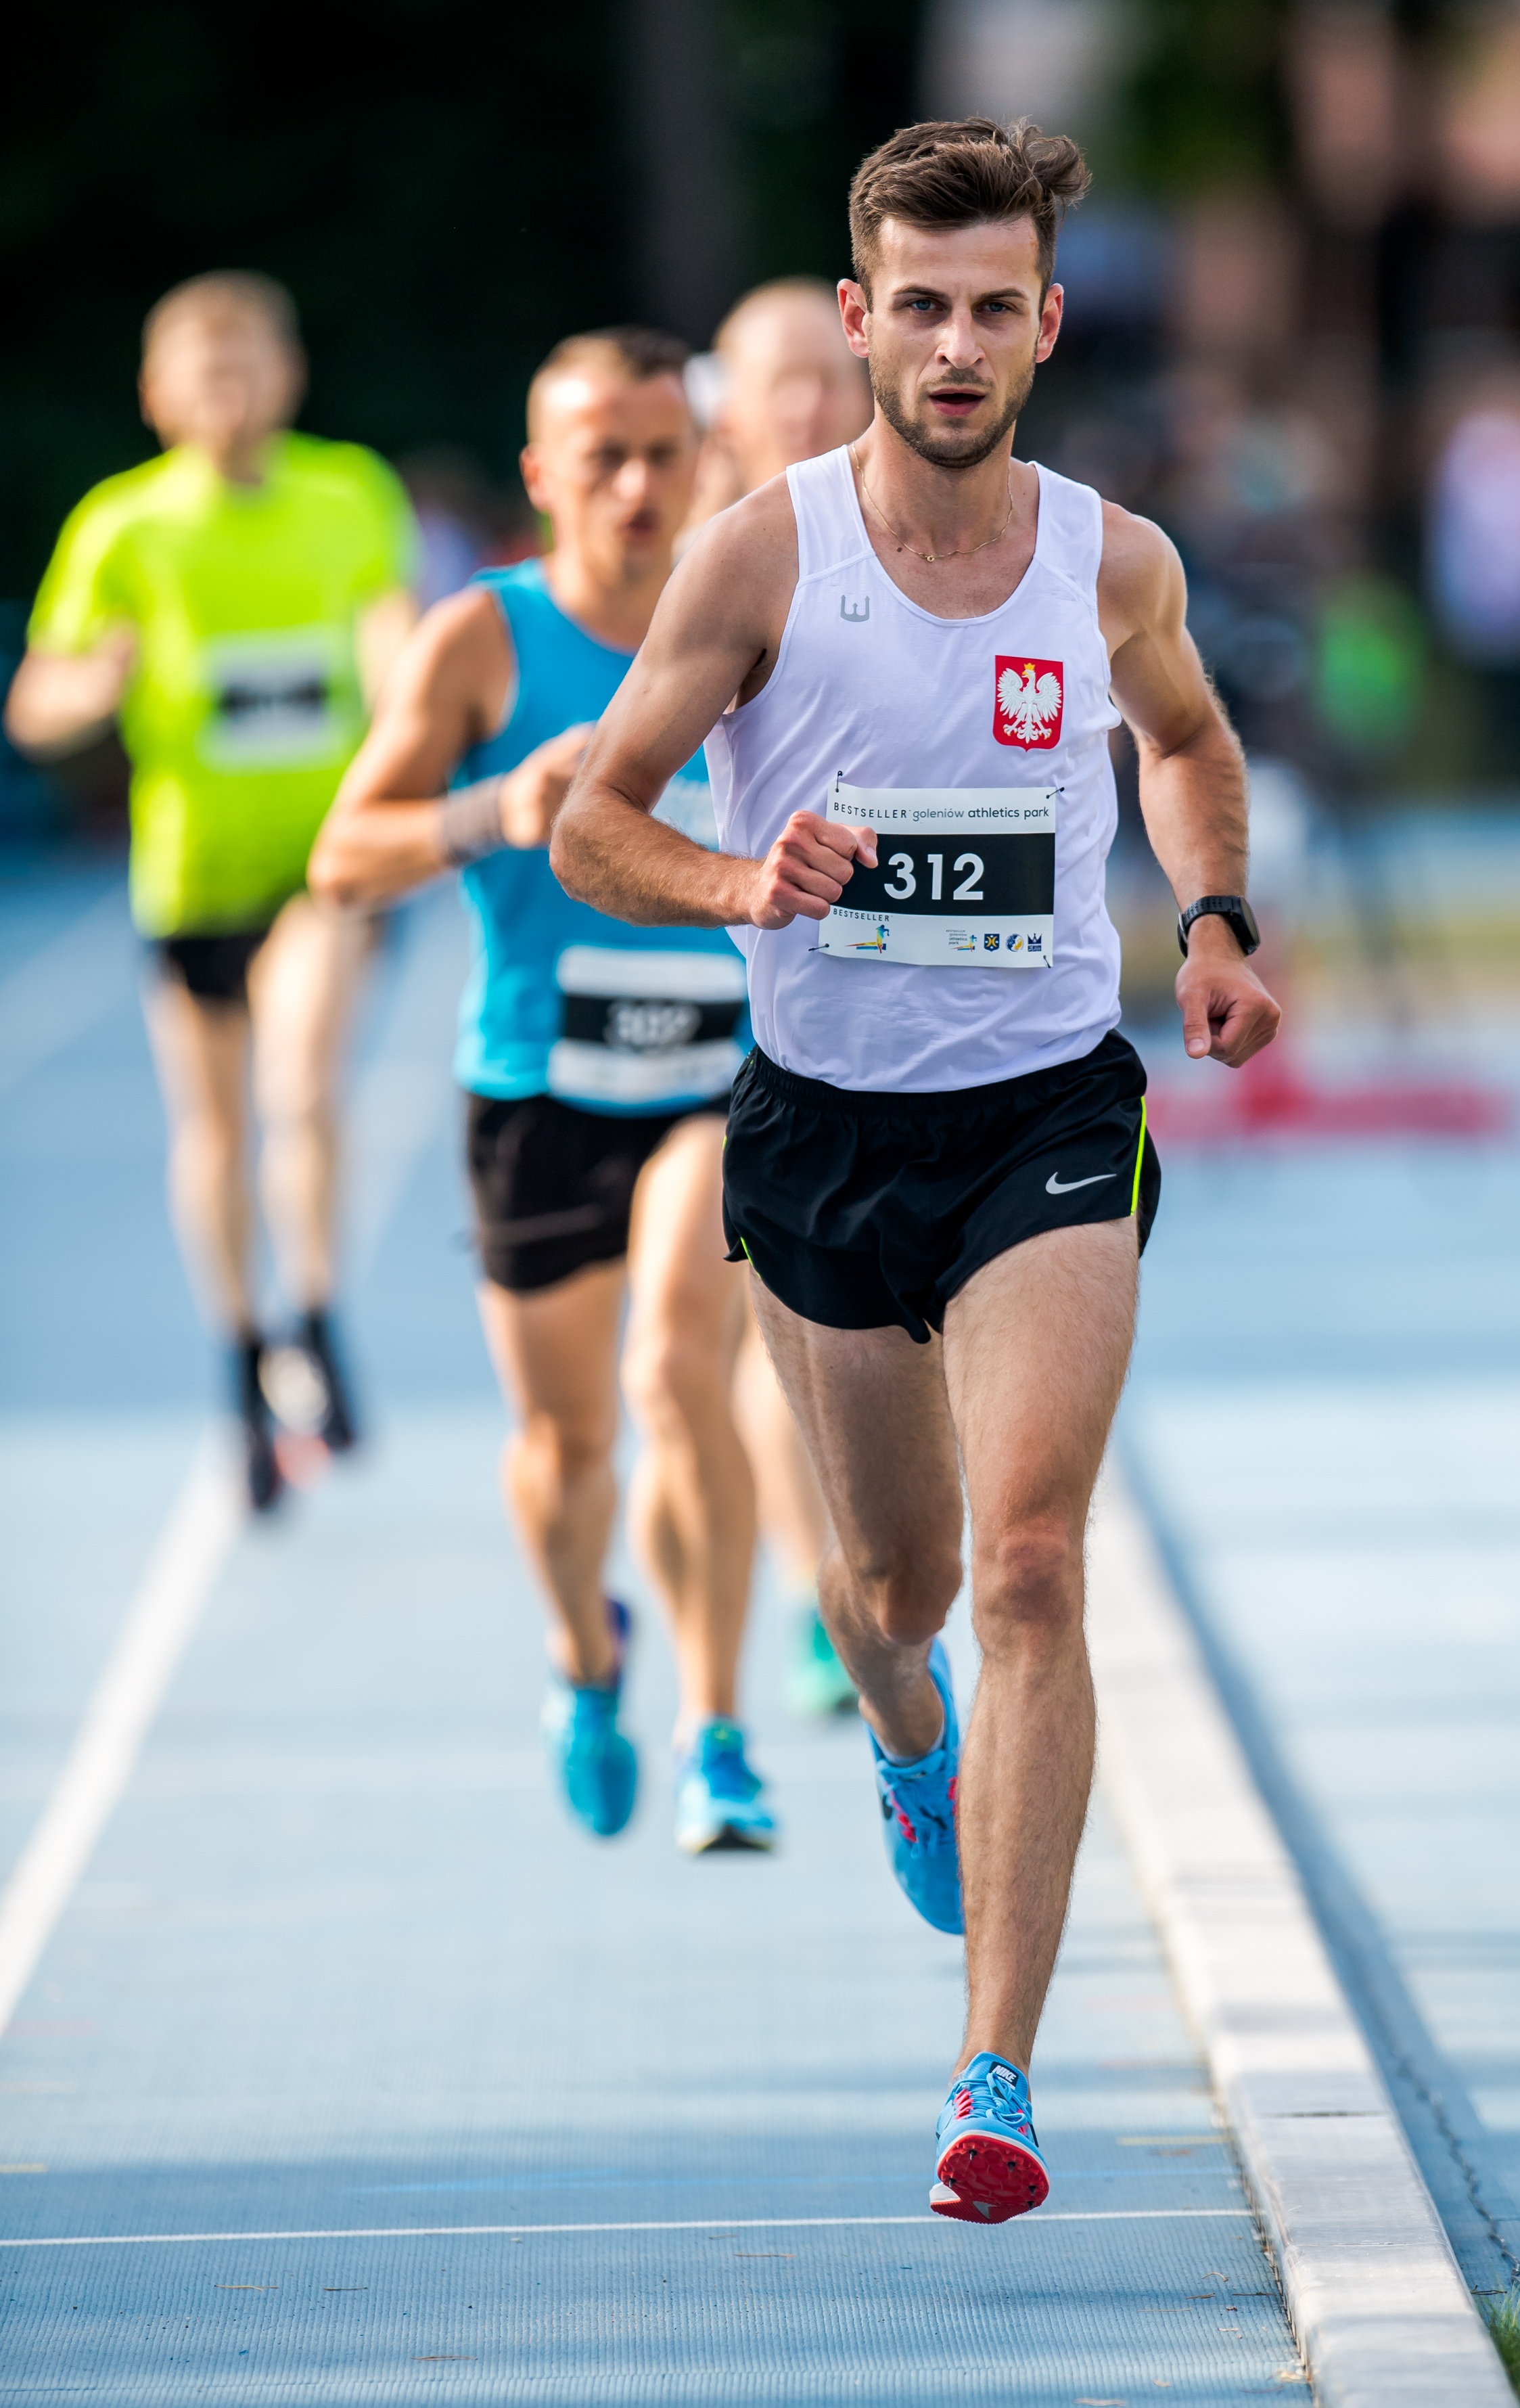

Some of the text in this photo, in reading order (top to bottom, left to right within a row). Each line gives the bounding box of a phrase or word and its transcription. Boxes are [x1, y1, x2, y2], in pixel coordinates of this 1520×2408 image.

[833, 802, 1049, 822] BESTSELLER goleniów athletics park
[883, 853, 985, 901] 312
[833, 908, 890, 922] BESTSELLER
[992, 2064, 1017, 2083] NIKE
